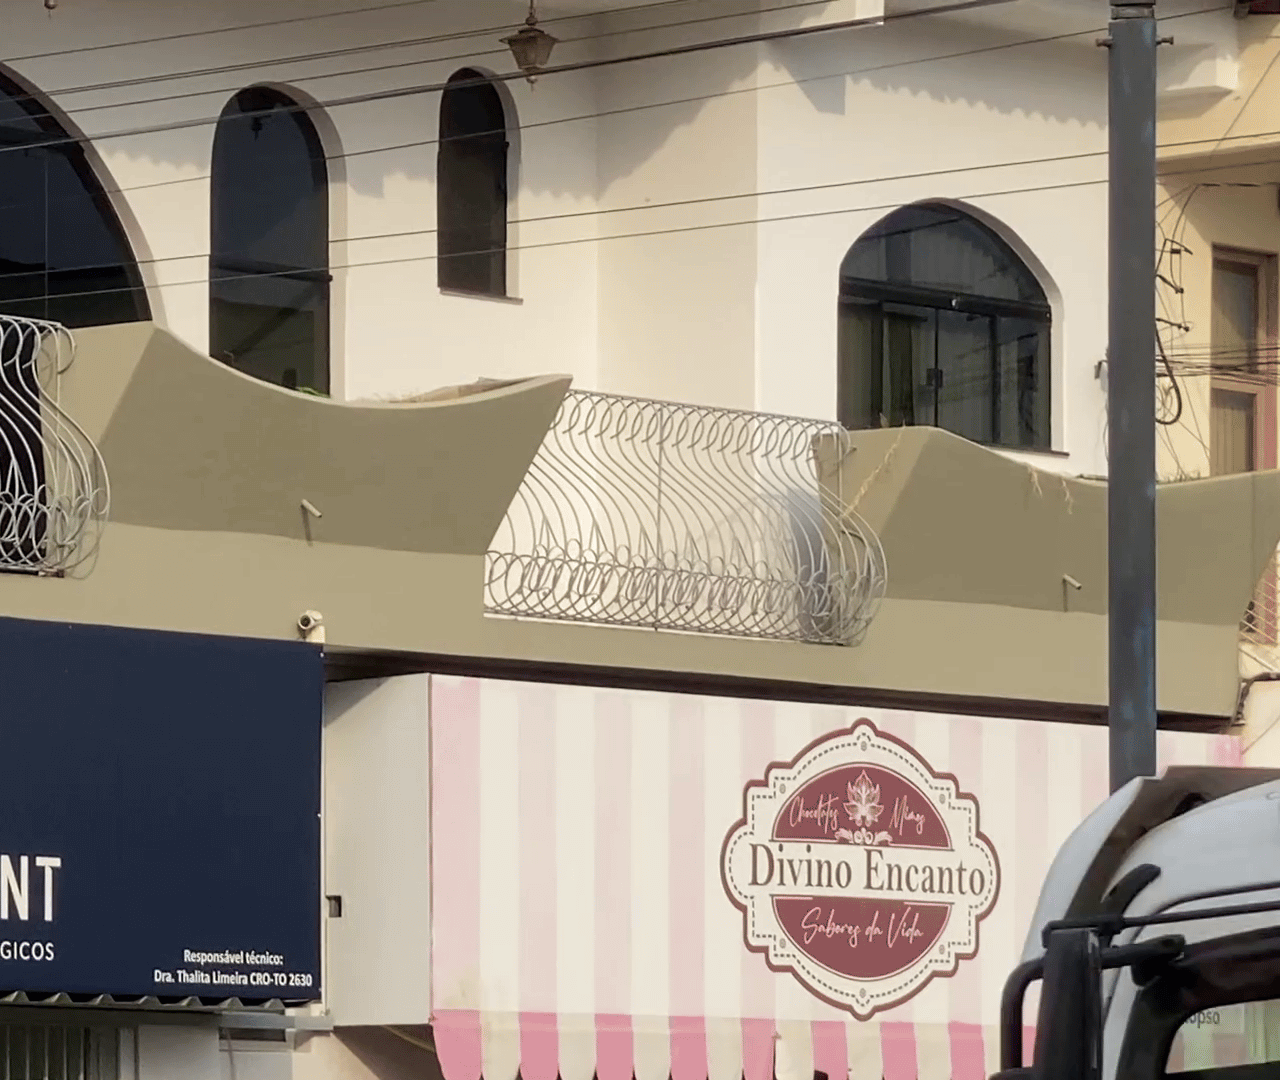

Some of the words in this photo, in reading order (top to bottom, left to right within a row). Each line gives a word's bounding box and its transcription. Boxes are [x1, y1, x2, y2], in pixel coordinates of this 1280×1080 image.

[749, 843, 852, 888] Divino
[863, 849, 985, 895] Encanto
[801, 907, 861, 948] Sabores
[865, 911, 882, 942] da
[887, 906, 923, 948] Vida
[184, 949, 243, 965] Responsável
[246, 952, 283, 965] técnico:
[154, 970, 175, 982] Dra.
[177, 970, 210, 984] Thalita
[212, 971, 248, 985] Limeira
[250, 972, 287, 985] CRO-TO
[289, 974, 312, 986] 2630
